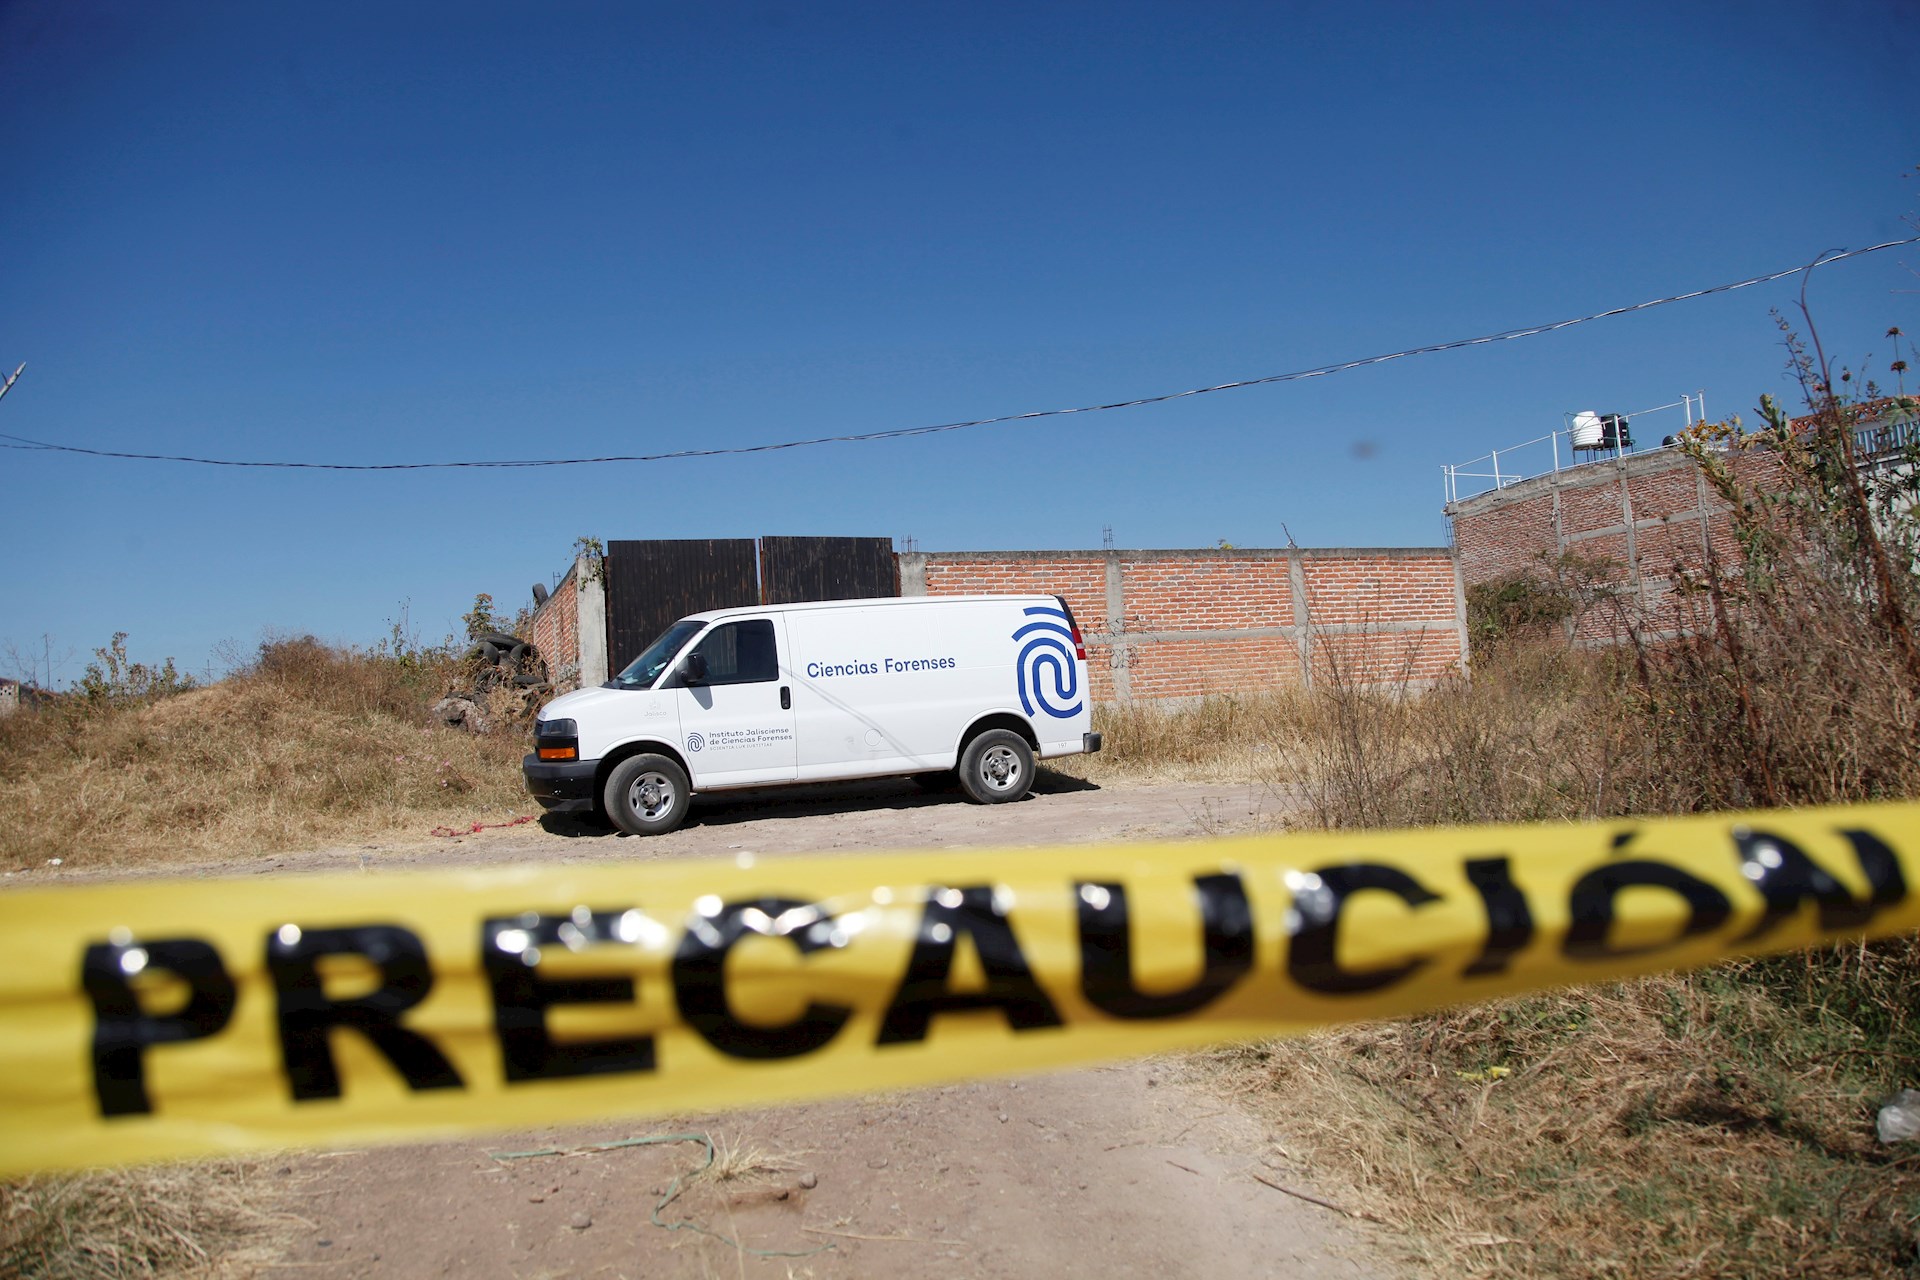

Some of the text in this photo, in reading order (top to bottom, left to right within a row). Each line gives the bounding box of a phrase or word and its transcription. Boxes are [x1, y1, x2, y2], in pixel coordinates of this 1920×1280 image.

[807, 657, 956, 678] Ciencias Forenses
[745, 728, 789, 736] Jalisciense
[81, 824, 1908, 1117] PRECAUCIÓN
